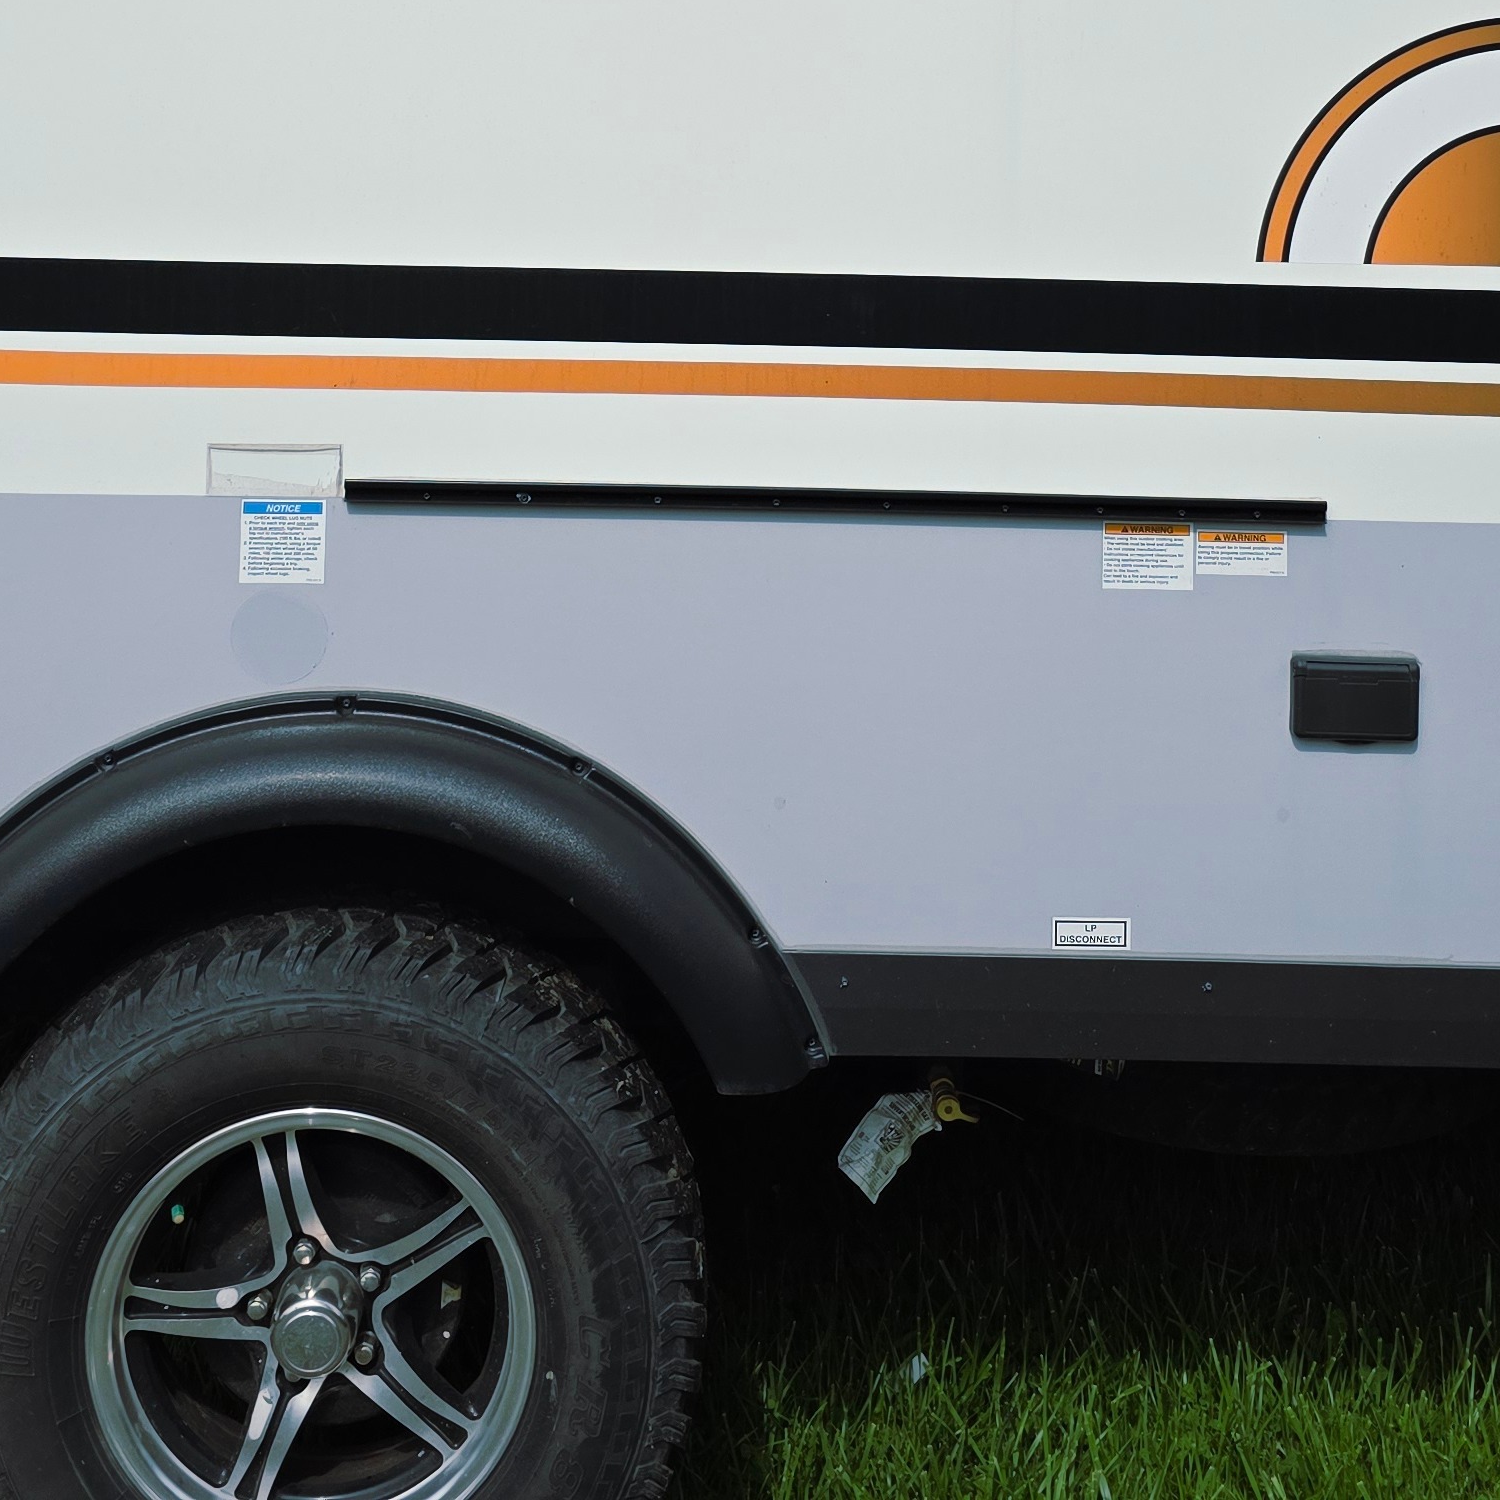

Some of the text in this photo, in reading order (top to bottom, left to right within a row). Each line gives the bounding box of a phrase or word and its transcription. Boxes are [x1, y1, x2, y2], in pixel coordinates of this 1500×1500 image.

[266, 504, 302, 513] NOTICE
[1130, 525, 1174, 535] WARNING
[1223, 533, 1267, 543] WARNING
[1084, 924, 1097, 932] LP
[1059, 935, 1122, 944] DISCONNECT
[0, 1108, 143, 1378] WESTLAKE
